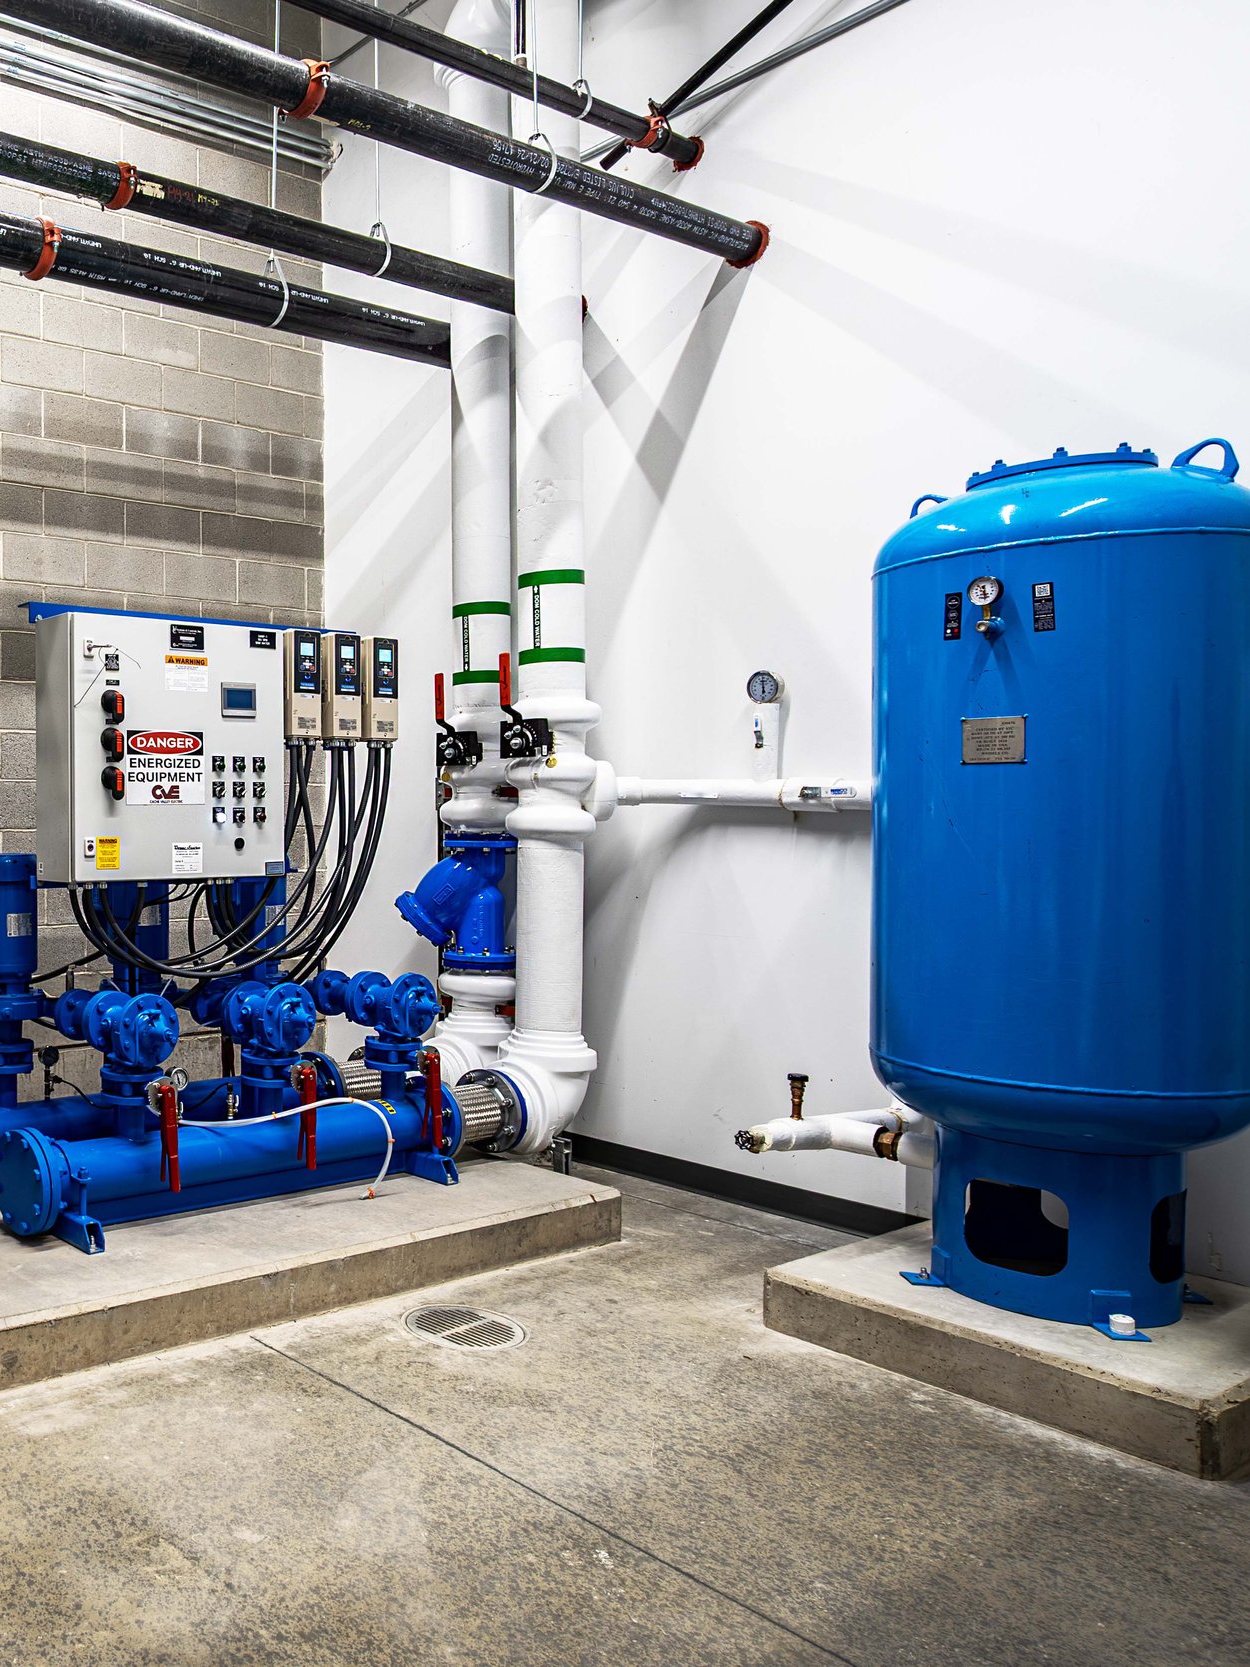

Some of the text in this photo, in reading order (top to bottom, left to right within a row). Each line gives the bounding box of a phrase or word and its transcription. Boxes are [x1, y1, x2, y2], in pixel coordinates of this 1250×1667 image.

[176, 658, 205, 666] WARNING
[136, 737, 194, 748] DANGER
[130, 758, 200, 768] ENERGIZED
[128, 772, 203, 783] EQUIPMENT
[152, 784, 180, 800] CVE
